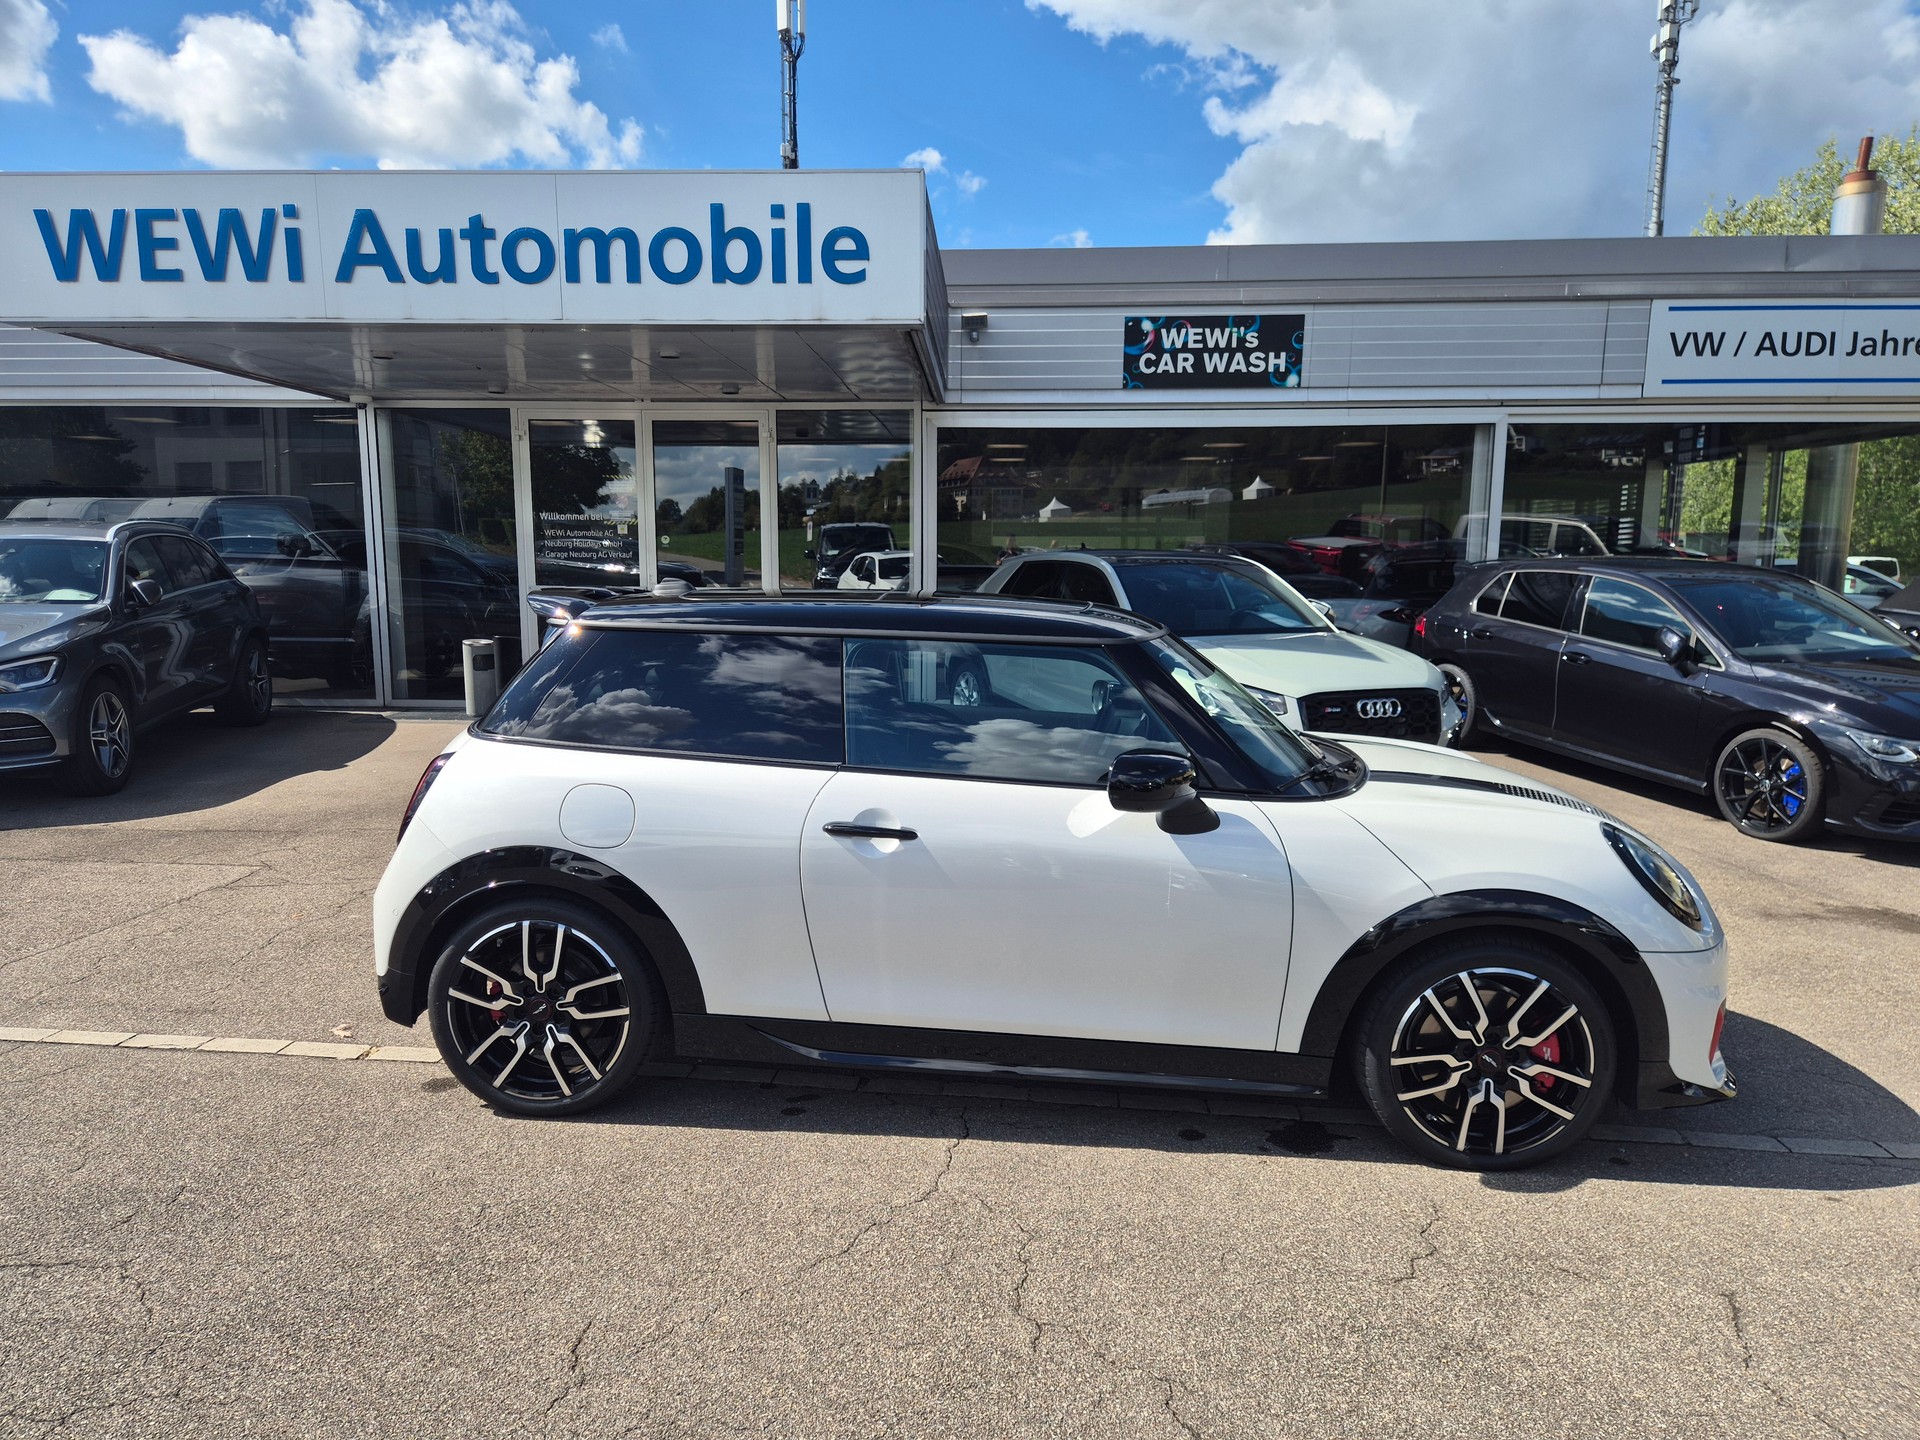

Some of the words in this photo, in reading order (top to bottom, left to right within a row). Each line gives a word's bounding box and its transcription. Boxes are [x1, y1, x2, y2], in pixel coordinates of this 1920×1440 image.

[33, 204, 304, 283] WEWi
[335, 203, 870, 285] Automobile
[1161, 327, 1259, 349] WEWi's
[1669, 331, 1726, 357] VW
[1754, 331, 1836, 357] AUDI
[1139, 353, 1195, 374] CAR
[1203, 352, 1287, 373] WASH
[540, 512, 590, 521] Willkommen
[591, 512, 604, 521] bei
[567, 529, 603, 537] Automobile
[545, 541, 573, 549] Neuburg
[574, 540, 602, 549] Holidays
[545, 551, 569, 560] Garage
[570, 551, 597, 560] Neuburg
[609, 551, 633, 559] Verkauf
